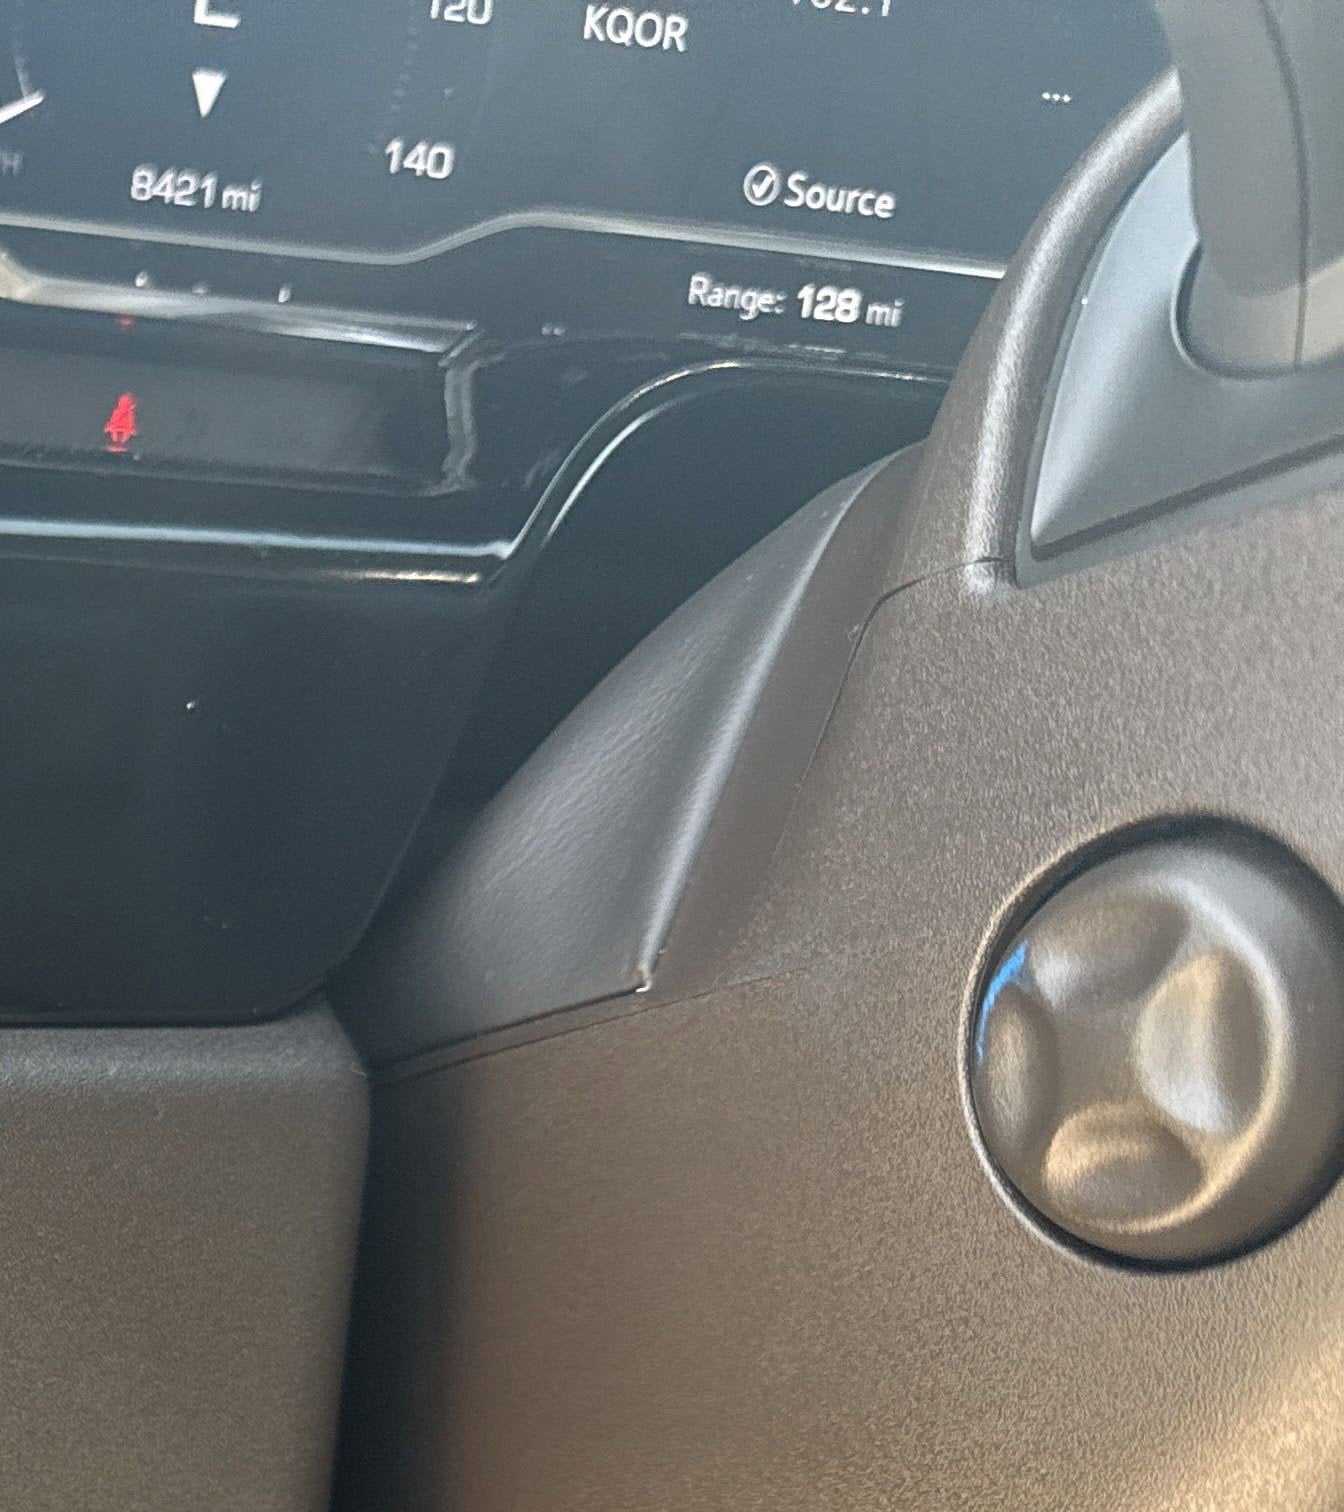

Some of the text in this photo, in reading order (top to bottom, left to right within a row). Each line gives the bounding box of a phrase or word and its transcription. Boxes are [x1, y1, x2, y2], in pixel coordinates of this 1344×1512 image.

[583, 4, 689, 52] KQOR
[385, 137, 455, 179] 140
[130, 163, 261, 213] 8421 mi
[783, 169, 897, 219] Source
[687, 271, 905, 328] Range: 128 mi
